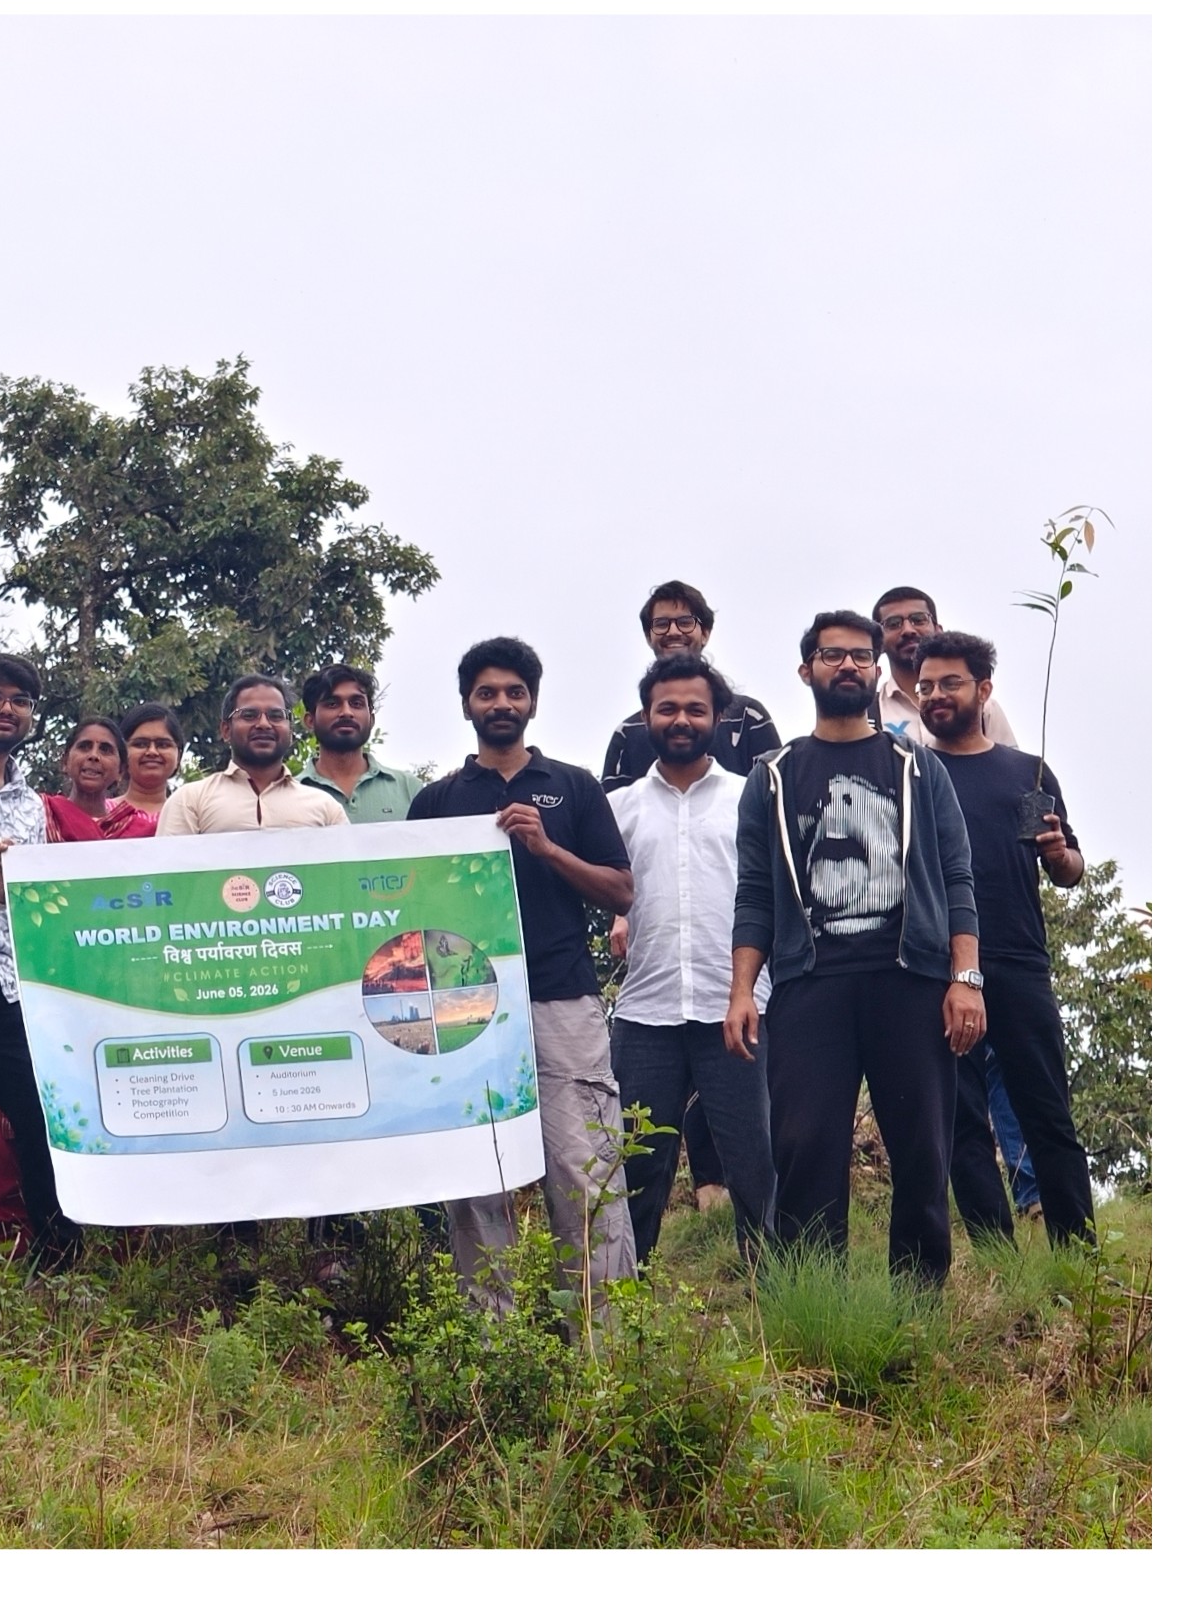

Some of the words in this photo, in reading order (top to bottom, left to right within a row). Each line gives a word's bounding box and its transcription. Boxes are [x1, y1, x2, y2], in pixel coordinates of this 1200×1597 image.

[268, 874, 298, 886] SCIENCE
[275, 898, 295, 906] CLUB
[74, 925, 162, 947] WORLD
[168, 913, 345, 941] ENVIRONMENT
[351, 909, 401, 929] DAY
[163, 943, 193, 965] विश्व
[195, 941, 257, 962] पर्यावरण
[261, 938, 303, 959] दिवस
[163, 968, 241, 983] #CLIMATE
[249, 964, 309, 978] ACTION
[196, 986, 226, 1000] June
[229, 986, 247, 999] 05,
[250, 984, 279, 997] 2026
[133, 1045, 193, 1061] Activities
[279, 1045, 323, 1058] Venue
[129, 1073, 168, 1084] Cleaning
[170, 1072, 195, 1082] Drive
[270, 1070, 317, 1079] Auditorium
[131, 1087, 151, 1096] Tree
[153, 1084, 198, 1094] Plantation
[280, 1088, 299, 1096] June
[300, 1086, 321, 1095] 2026
[132, 1097, 189, 1108] Photography
[303, 1103, 317, 1111] AM
[318, 1101, 356, 1111] Onwards
[133, 1109, 189, 1120] Competition
